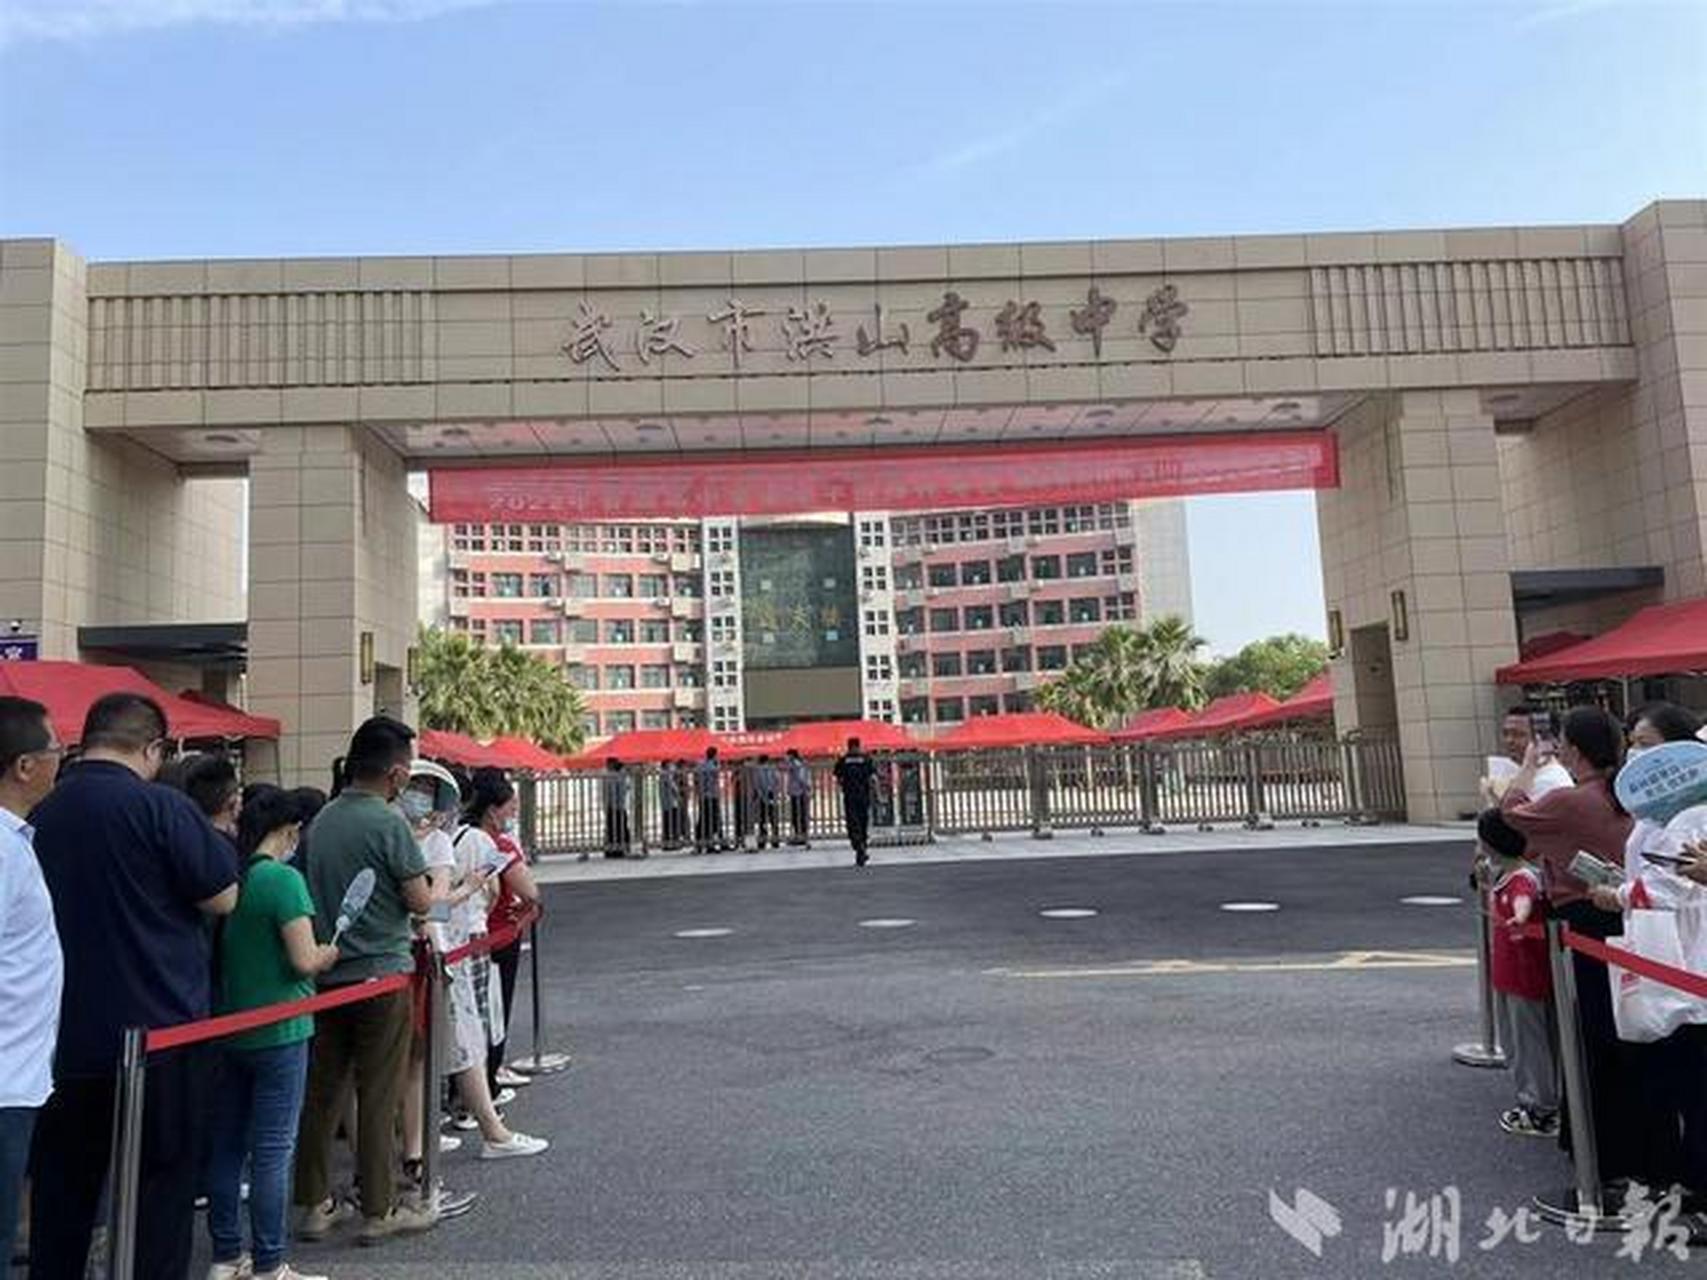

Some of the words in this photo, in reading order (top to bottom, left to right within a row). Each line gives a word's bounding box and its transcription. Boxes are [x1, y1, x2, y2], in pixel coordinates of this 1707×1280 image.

[562, 284, 1191, 373] 武汉市洪山高级中学
